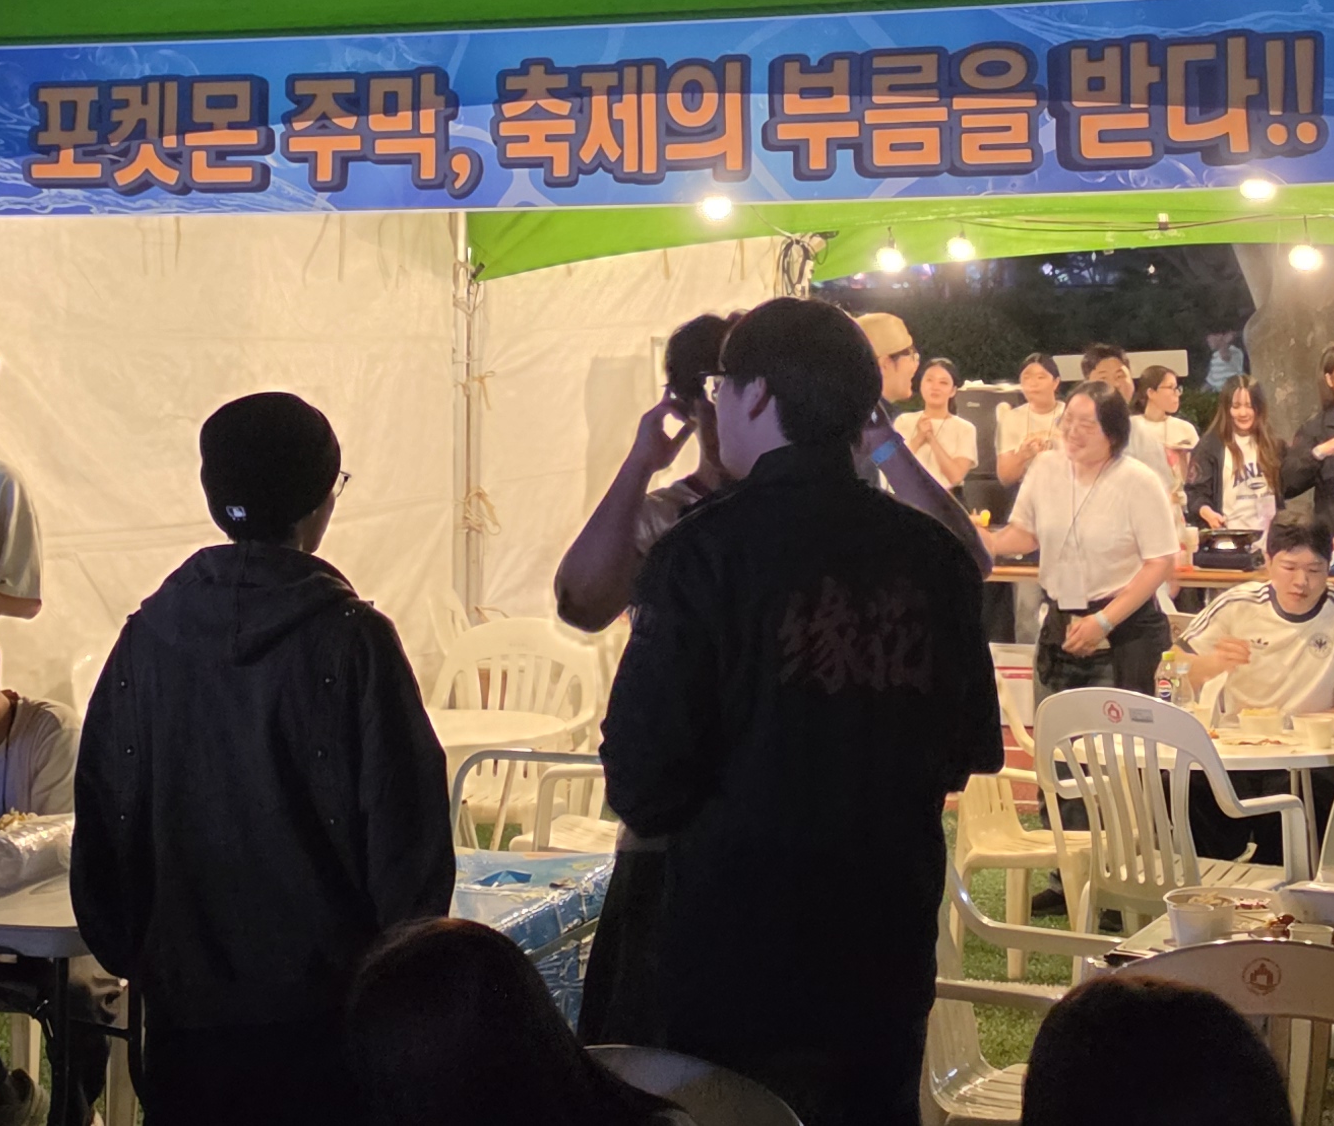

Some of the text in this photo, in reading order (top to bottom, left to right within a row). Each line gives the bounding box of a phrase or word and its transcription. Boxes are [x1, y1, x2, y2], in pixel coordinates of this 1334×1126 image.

[28, 33, 1321, 192] 포켓몬 주막, 축제의 부름을 받다!!
